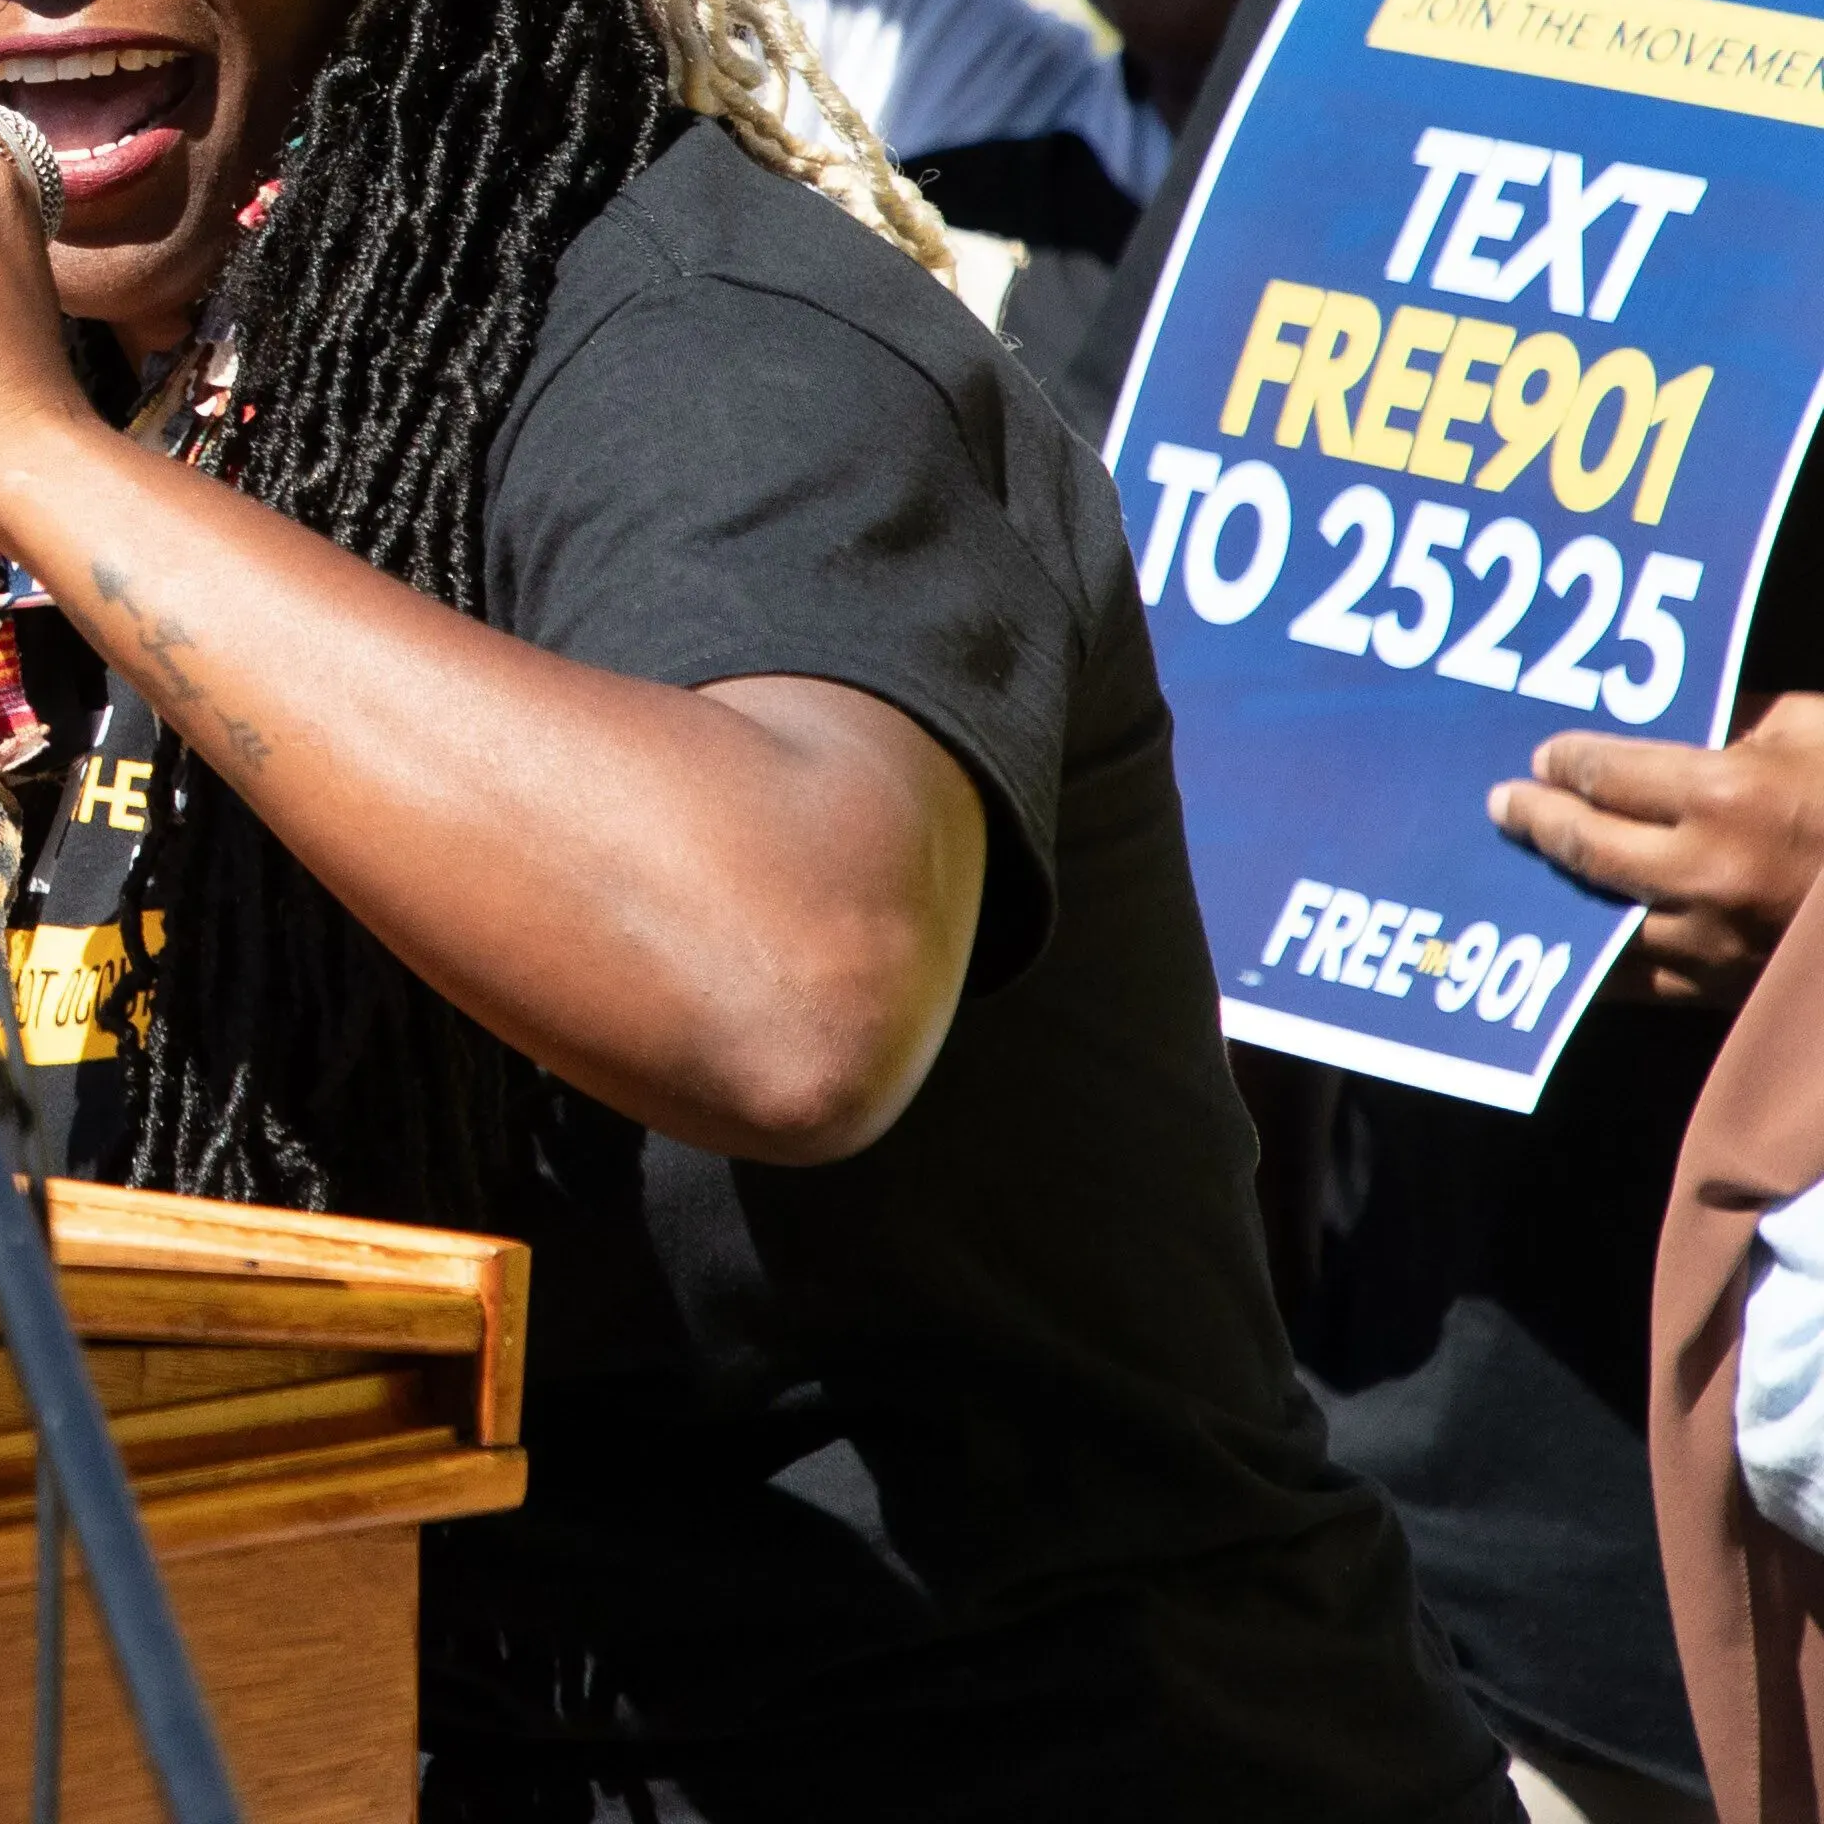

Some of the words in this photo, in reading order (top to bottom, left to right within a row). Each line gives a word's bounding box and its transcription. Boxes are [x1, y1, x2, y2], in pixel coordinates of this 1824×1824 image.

[1517, 0, 1598, 51] THE
[1382, 125, 1709, 325] TEXT
[1218, 279, 1715, 526] FREE901
[1140, 441, 1294, 627] TO
[1287, 482, 1705, 727] 25225
[1260, 877, 1444, 999] FREE
